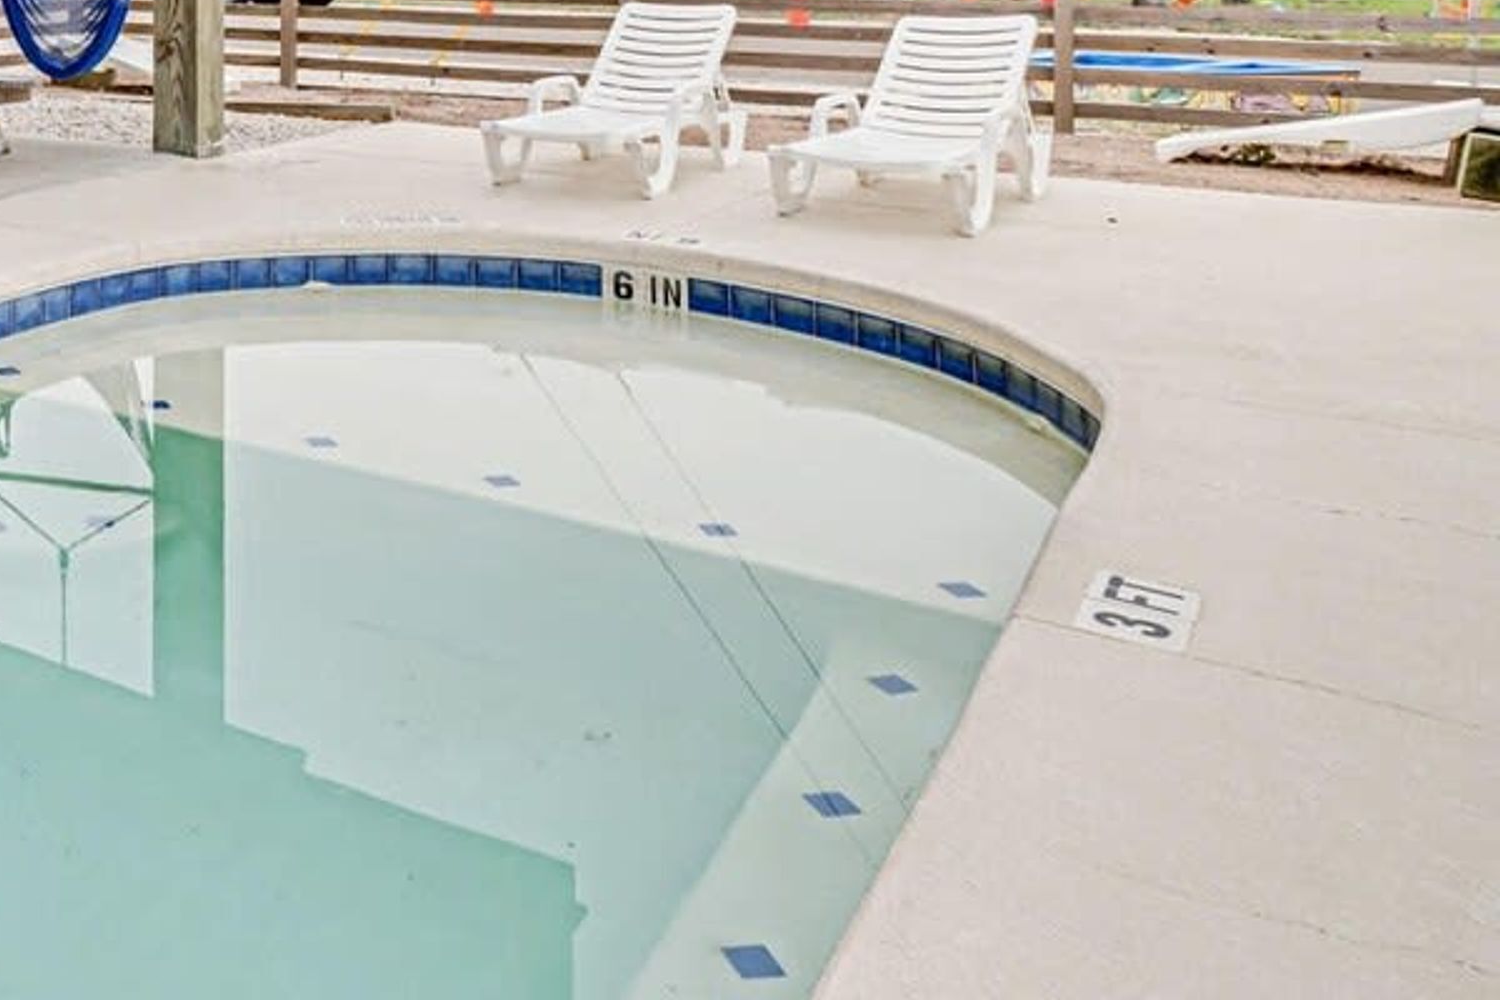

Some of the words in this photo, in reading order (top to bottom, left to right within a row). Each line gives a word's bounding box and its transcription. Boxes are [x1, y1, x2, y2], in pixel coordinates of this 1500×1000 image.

[613, 270, 634, 300] 6
[650, 275, 682, 309] IN
[1103, 574, 1186, 616] FT
[1093, 611, 1171, 639] 3
